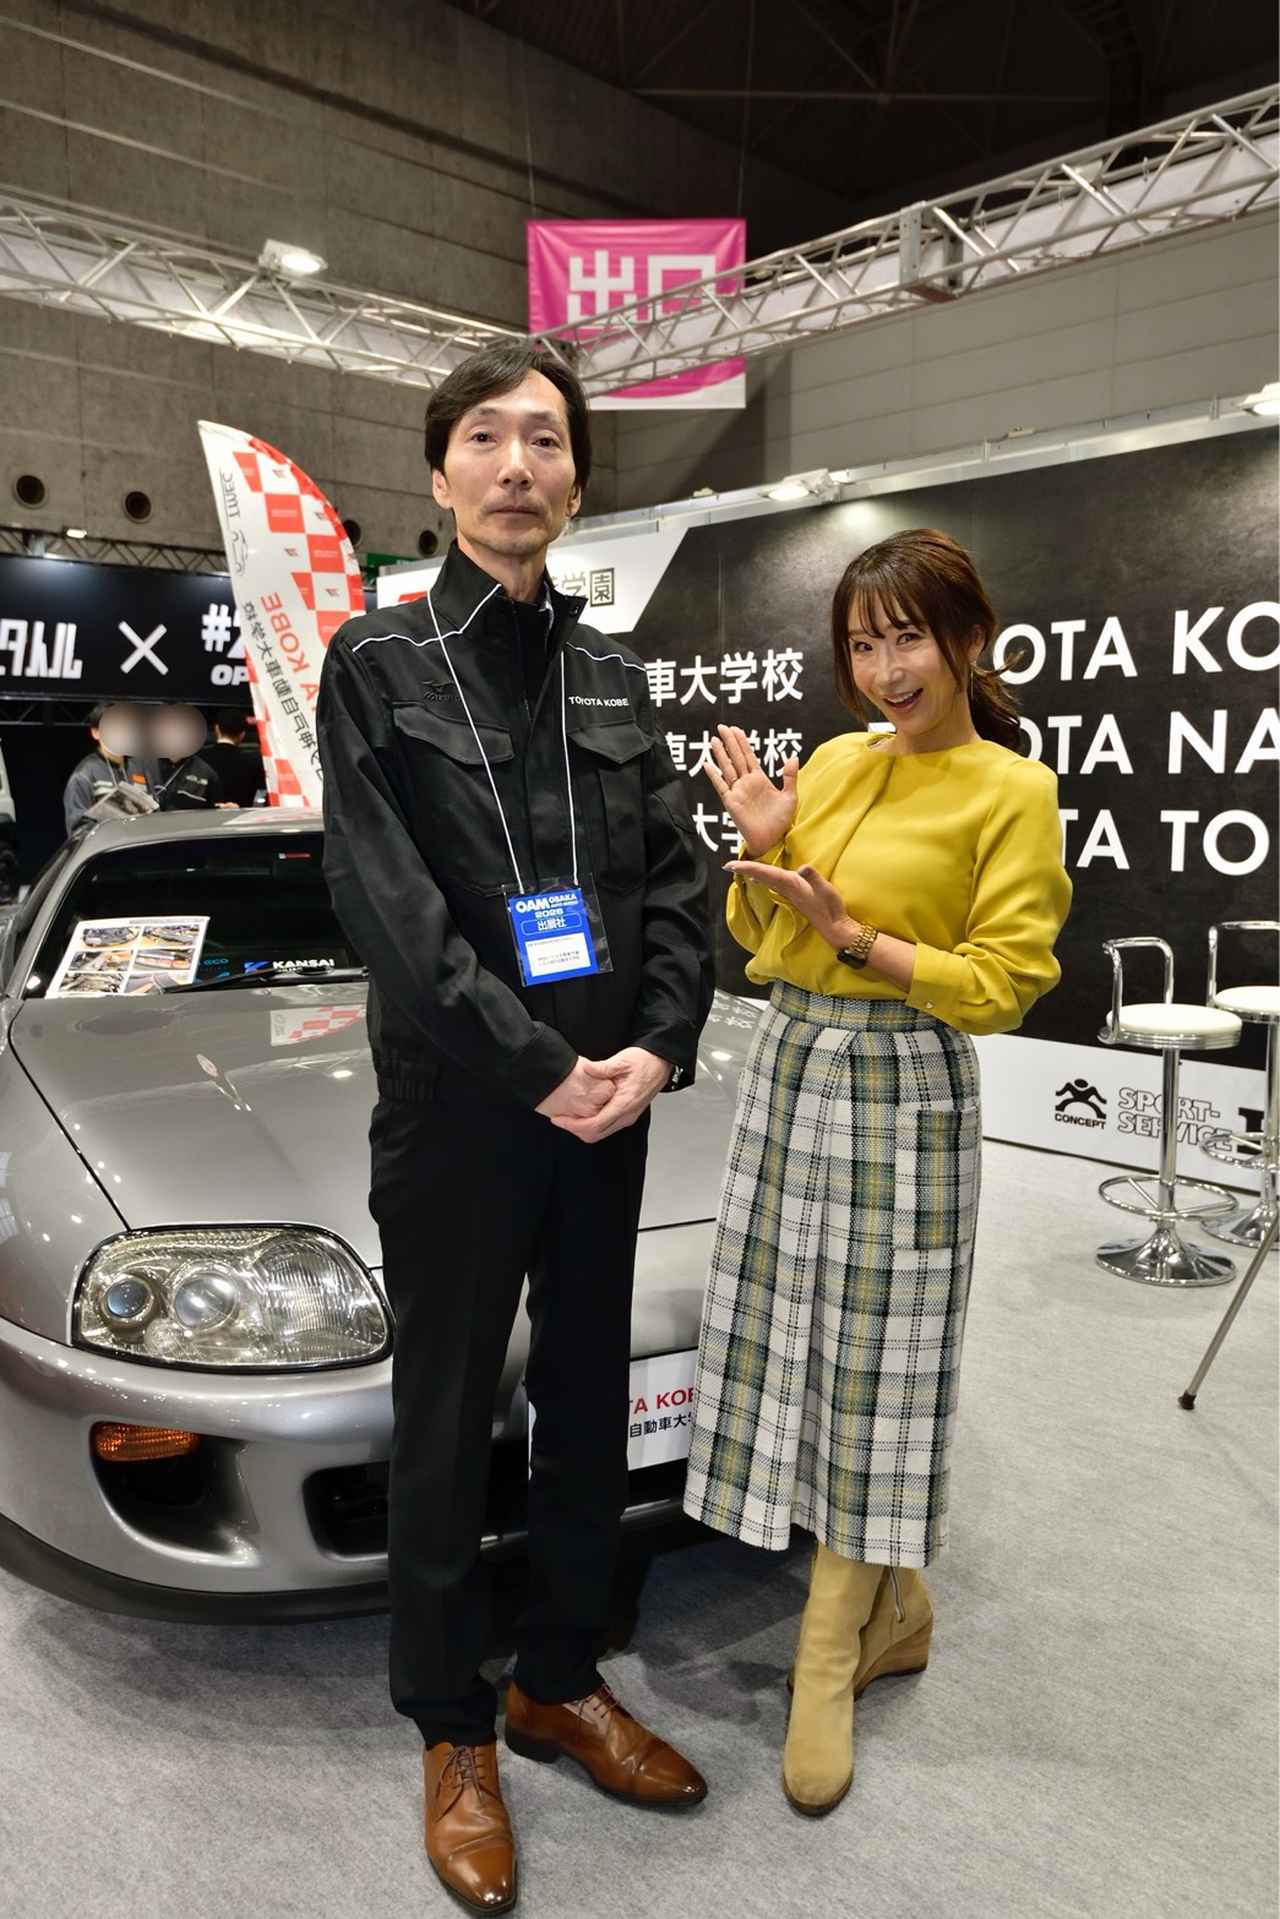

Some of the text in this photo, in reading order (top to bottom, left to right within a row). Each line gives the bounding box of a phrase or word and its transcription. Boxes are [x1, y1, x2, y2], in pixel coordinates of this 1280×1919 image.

[568, 250, 715, 329] 出口
[555, 568, 614, 607] 学園
[1160, 810, 1270, 876] TO
[515, 897, 550, 913] OAM
[273, 959, 335, 971] KANSAI
[1054, 1113, 1106, 1130] CONCEPT
[629, 1411, 692, 1438] 自動車大
